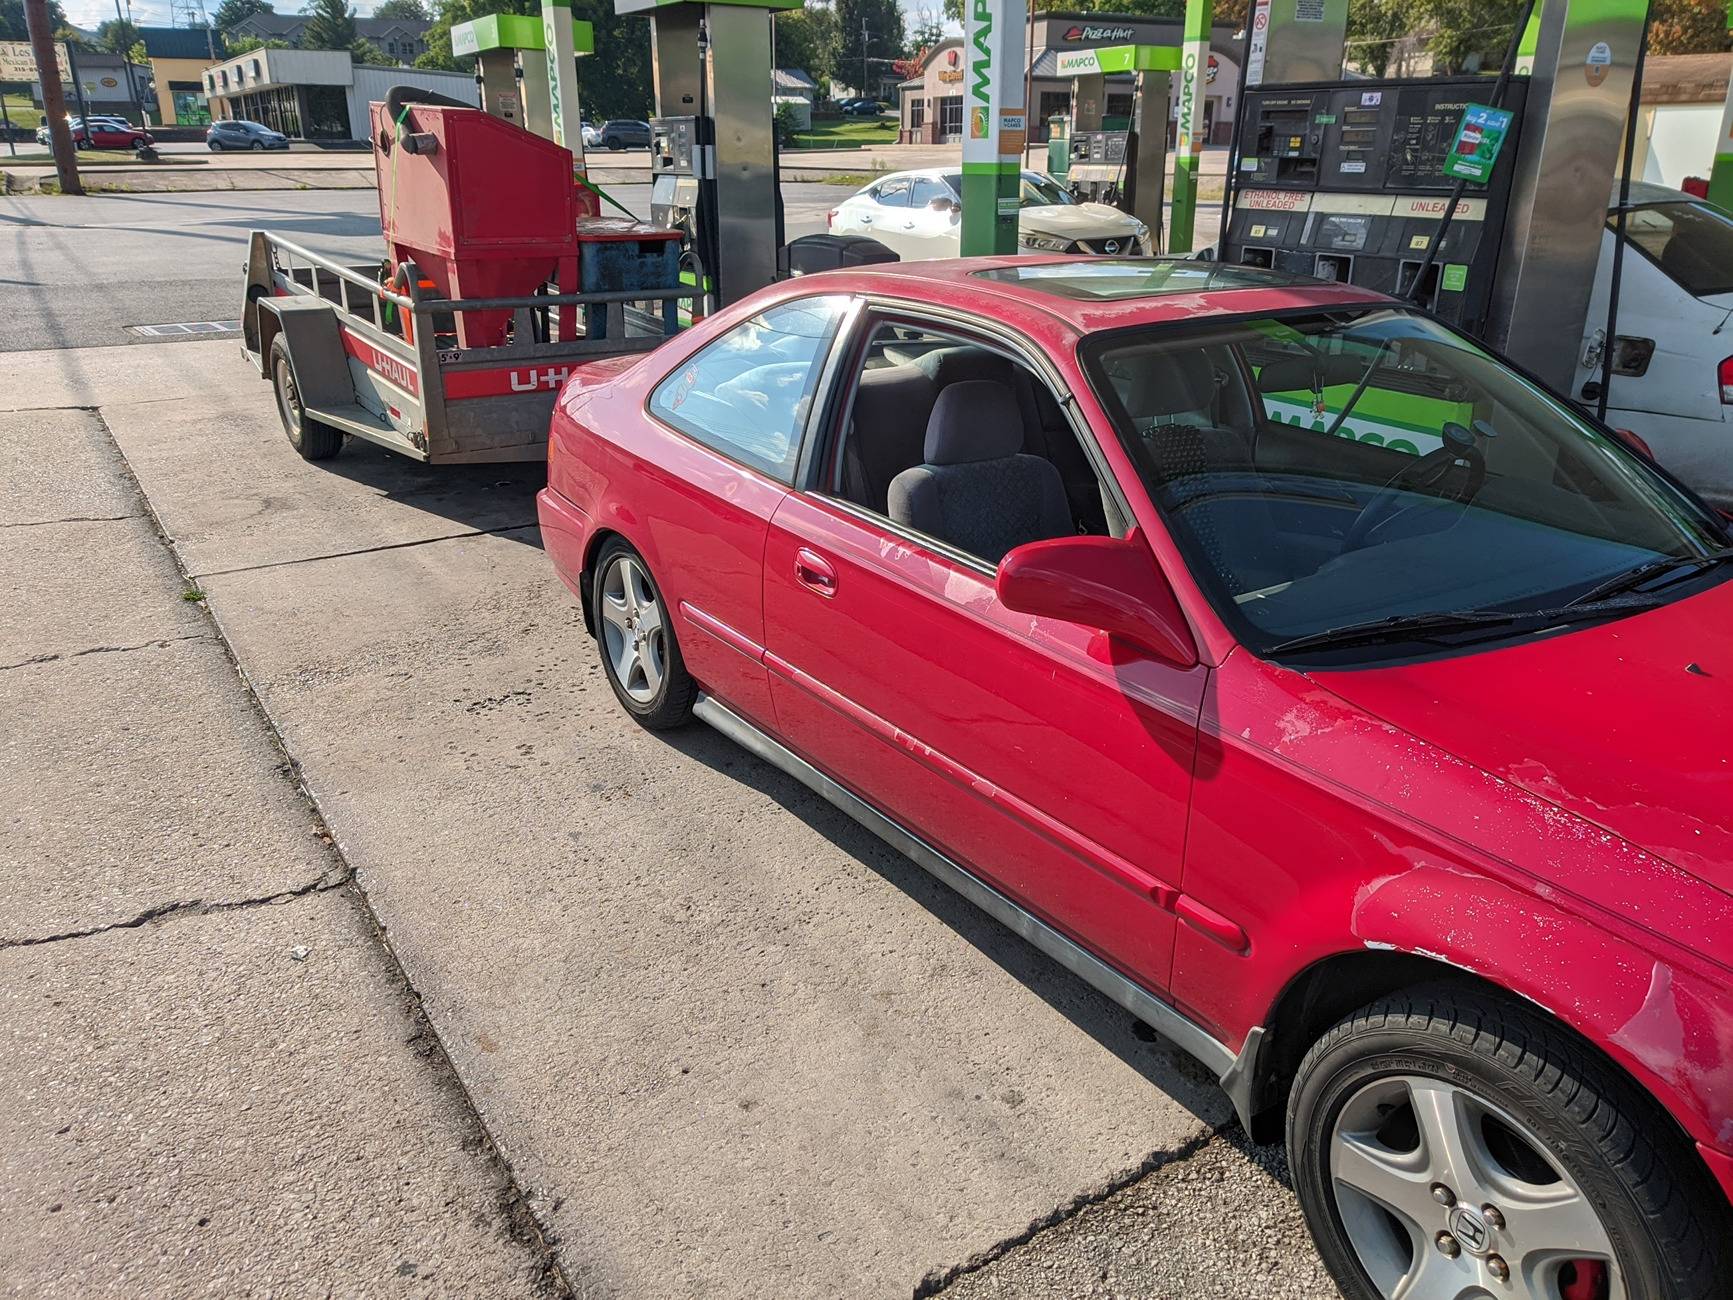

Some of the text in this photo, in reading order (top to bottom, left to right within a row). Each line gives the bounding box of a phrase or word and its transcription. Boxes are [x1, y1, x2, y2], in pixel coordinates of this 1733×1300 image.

[1081, 26, 1135, 41] Pizza Hut
[1065, 56, 1096, 68] MAPCO
[1122, 53, 1130, 65] 7
[545, 23, 562, 130] MAPCO
[1180, 53, 1196, 132] MAPCO
[1477, 113, 1487, 124] 2
[1244, 190, 1306, 202] ETHANOL FREE
[1248, 200, 1296, 210] UNLEADED
[1410, 201, 1470, 214] UNLEAED
[371, 348, 414, 391] U-HAUL
[510, 366, 569, 392] U-H
